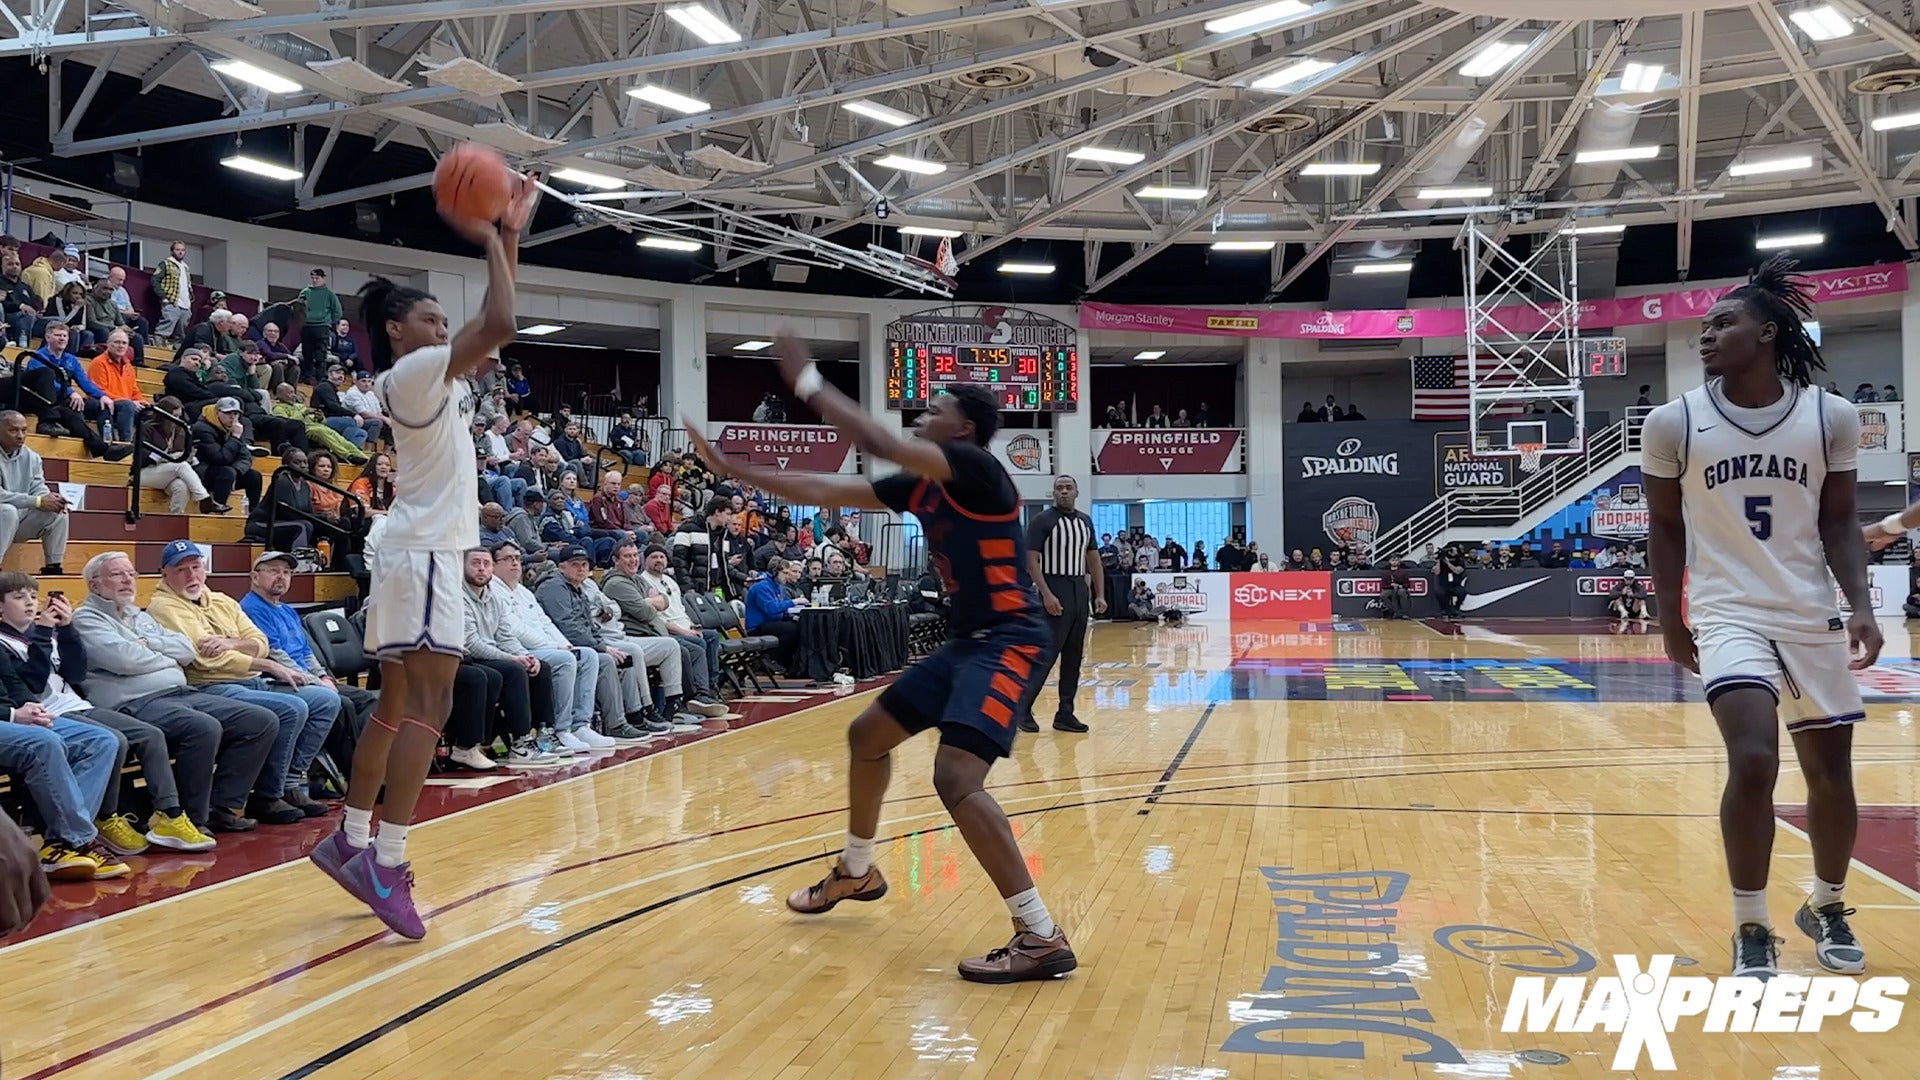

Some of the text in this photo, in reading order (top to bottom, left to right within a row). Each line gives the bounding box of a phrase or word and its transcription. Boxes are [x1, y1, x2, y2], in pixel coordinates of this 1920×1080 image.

[1095, 311, 1174, 327] Morgan Stanley
[1300, 322, 1345, 335] SPALDING
[907, 348, 913, 358] 0
[932, 346, 953, 354] HOME
[970, 348, 1007, 363] 7:45
[1011, 348, 1038, 356] VISITOR
[907, 358, 913, 368] 0
[935, 356, 953, 372] 32
[1018, 358, 1037, 374] 30
[1591, 354, 1621, 375] 21
[990, 369, 998, 381] 3
[889, 379, 900, 387] 24
[889, 389, 900, 398] 32
[1029, 391, 1037, 403] 0
[726, 428, 838, 444] SPRINGFIELD
[1111, 433, 1221, 444] SPRINGFIELD
[754, 445, 811, 454] COLLEGE
[1139, 447, 1194, 455] COLLEGE
[1302, 452, 1400, 478] SPALDING
[1444, 462, 1504, 473] NATIONAL
[1704, 454, 1808, 490] GONZAGA
[1444, 472, 1504, 486] GUARD
[1597, 512, 1649, 526] HOOPHA
[1744, 495, 1773, 541] 5
[175, 542, 188, 552] B
[1270, 588, 1326, 600] NEXT
[1219, 866, 1467, 1066] SPALDING
